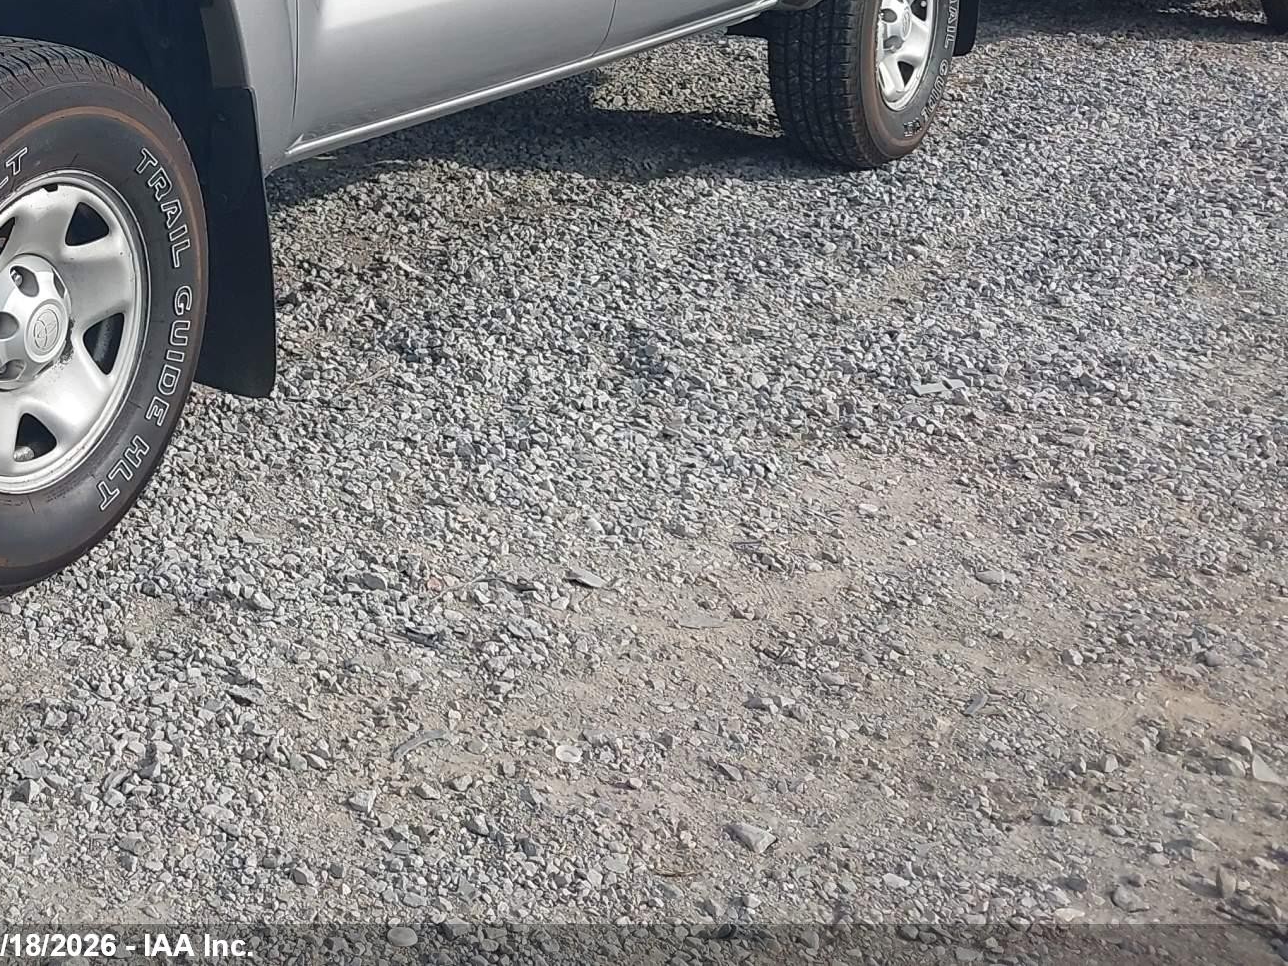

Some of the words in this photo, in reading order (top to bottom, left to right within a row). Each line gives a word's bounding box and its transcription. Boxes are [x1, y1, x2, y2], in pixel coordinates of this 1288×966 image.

[133, 147, 192, 268] TRAIL
[144, 285, 193, 427] GUIDE
[98, 435, 150, 510] HLT
